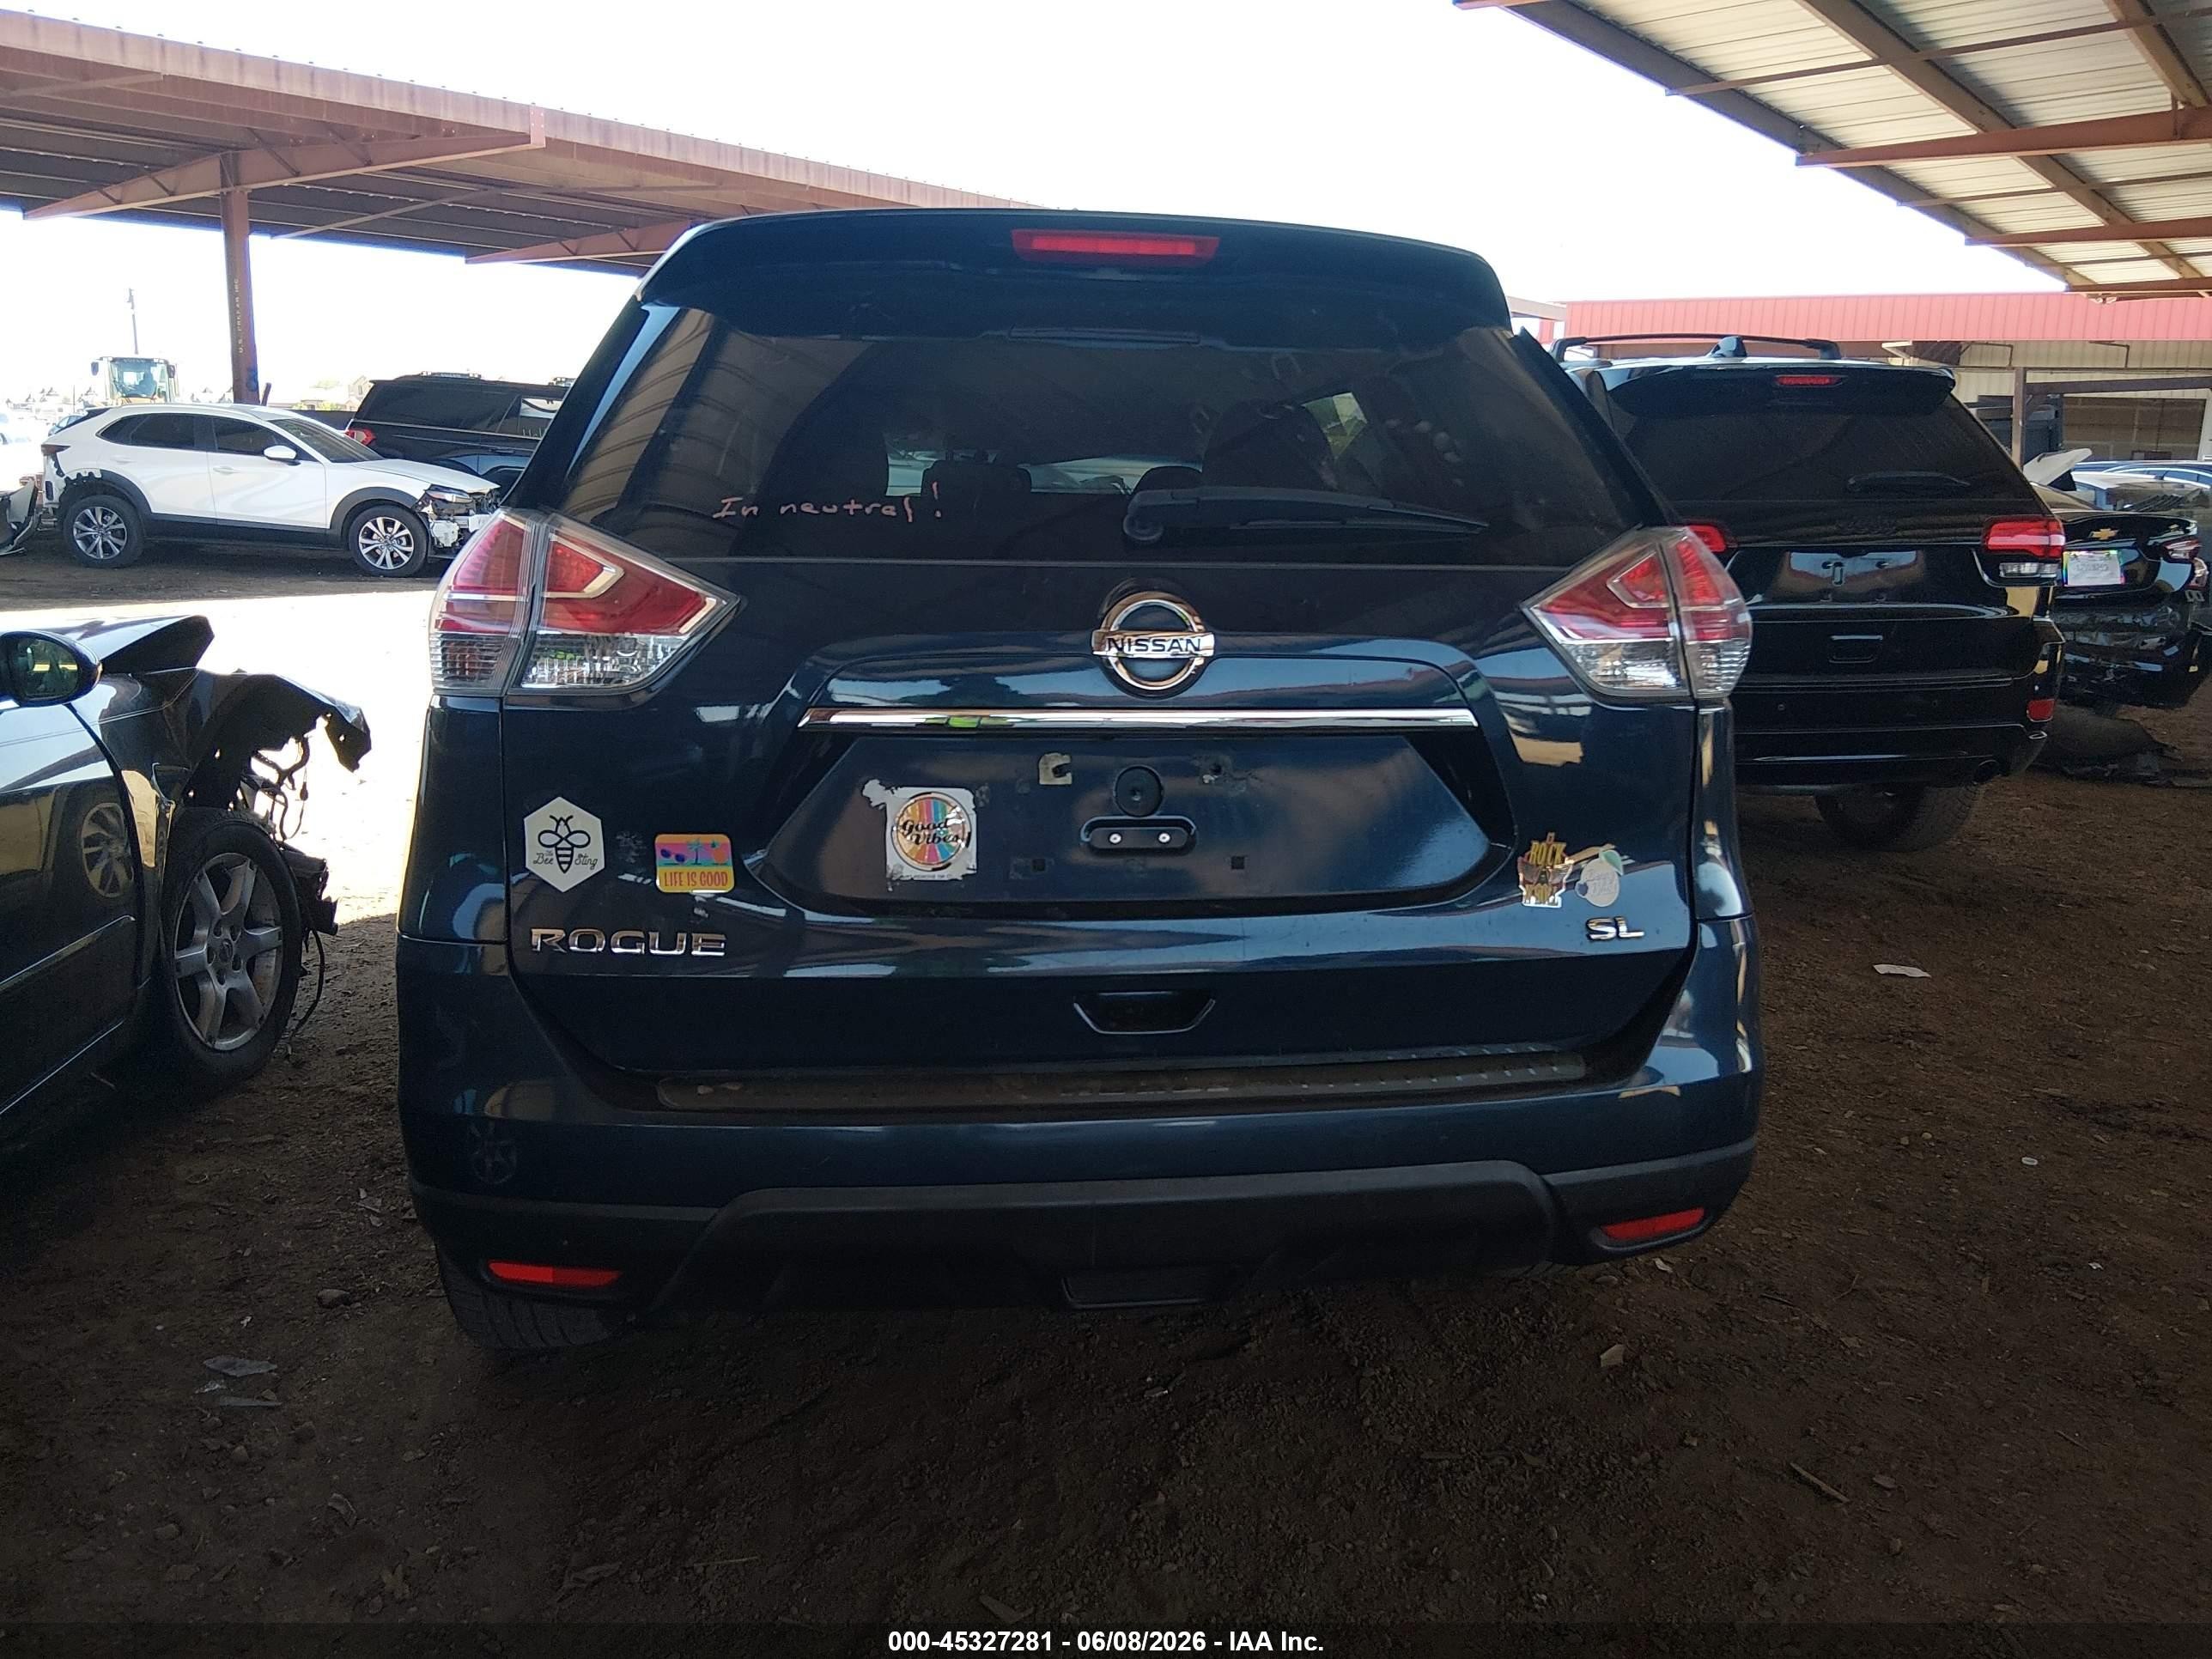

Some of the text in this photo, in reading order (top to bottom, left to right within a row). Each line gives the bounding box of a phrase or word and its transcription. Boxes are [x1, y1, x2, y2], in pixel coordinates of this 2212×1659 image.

[713, 496, 759, 520] In
[1105, 637, 1201, 653] NISSAN
[901, 818, 950, 838] Good
[909, 830, 961, 846] Vibes
[532, 853, 599, 871] Bee Sting
[1528, 840, 1567, 866] ROCK
[664, 871, 729, 888] LIFE IS GOOD
[1585, 916, 1645, 941] SL
[531, 928, 726, 957] ROGUE
